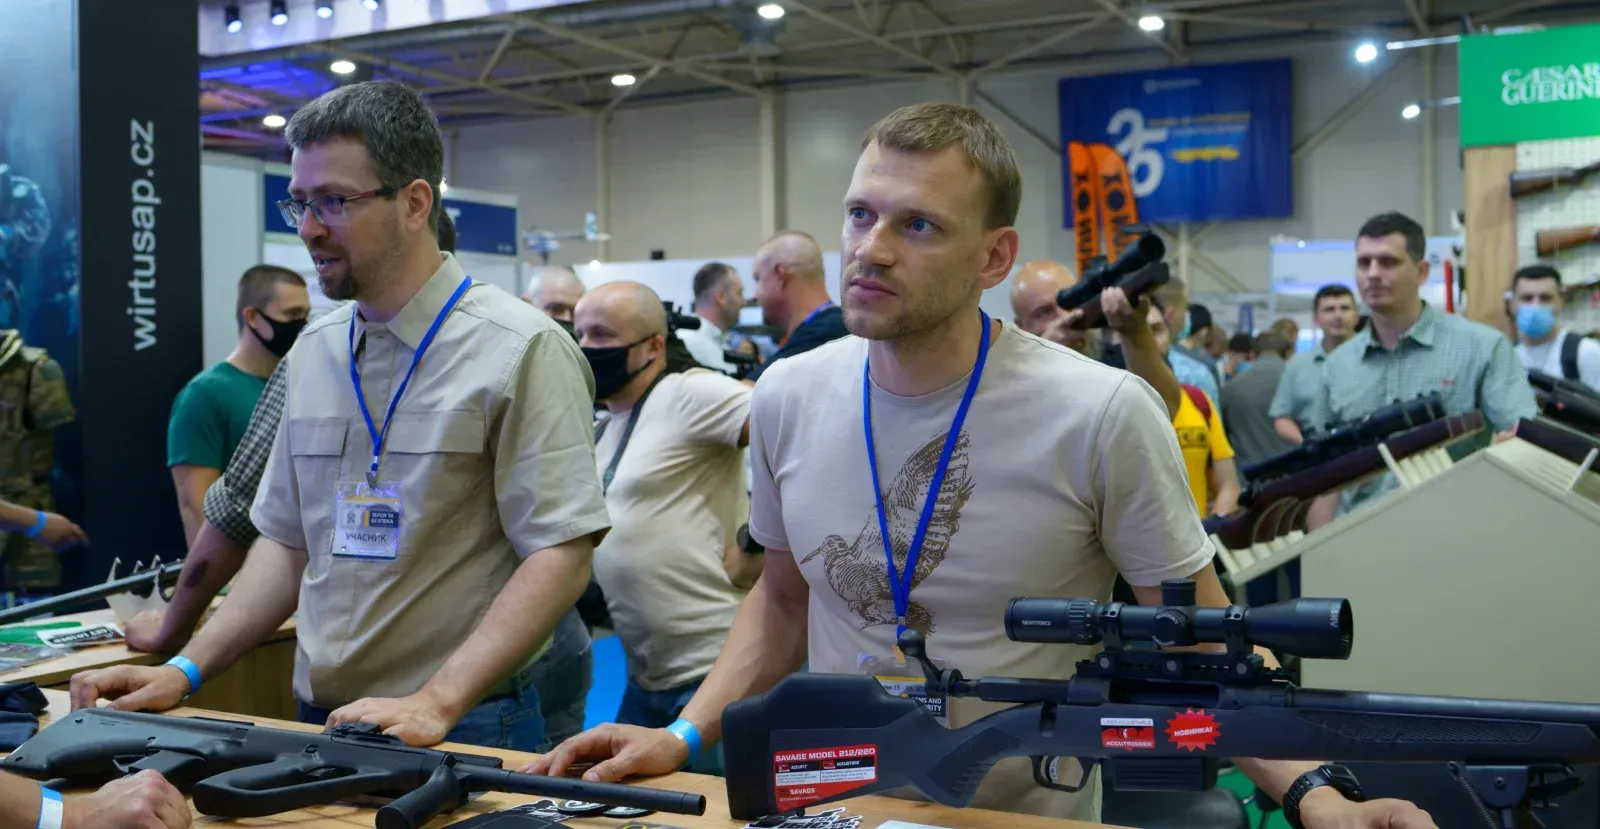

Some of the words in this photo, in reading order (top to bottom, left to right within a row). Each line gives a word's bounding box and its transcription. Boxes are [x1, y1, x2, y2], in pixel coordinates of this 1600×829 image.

[126, 118, 162, 351] wirtusap.cz
[345, 532, 387, 542] УЧАСНИК
[1174, 727, 1213, 737] НОВИНКА!
[775, 752, 807, 762] SAVAGE
[808, 751, 837, 760] MODEL
[839, 748, 876, 757] 212/220
[789, 787, 816, 795] SAVAGE
